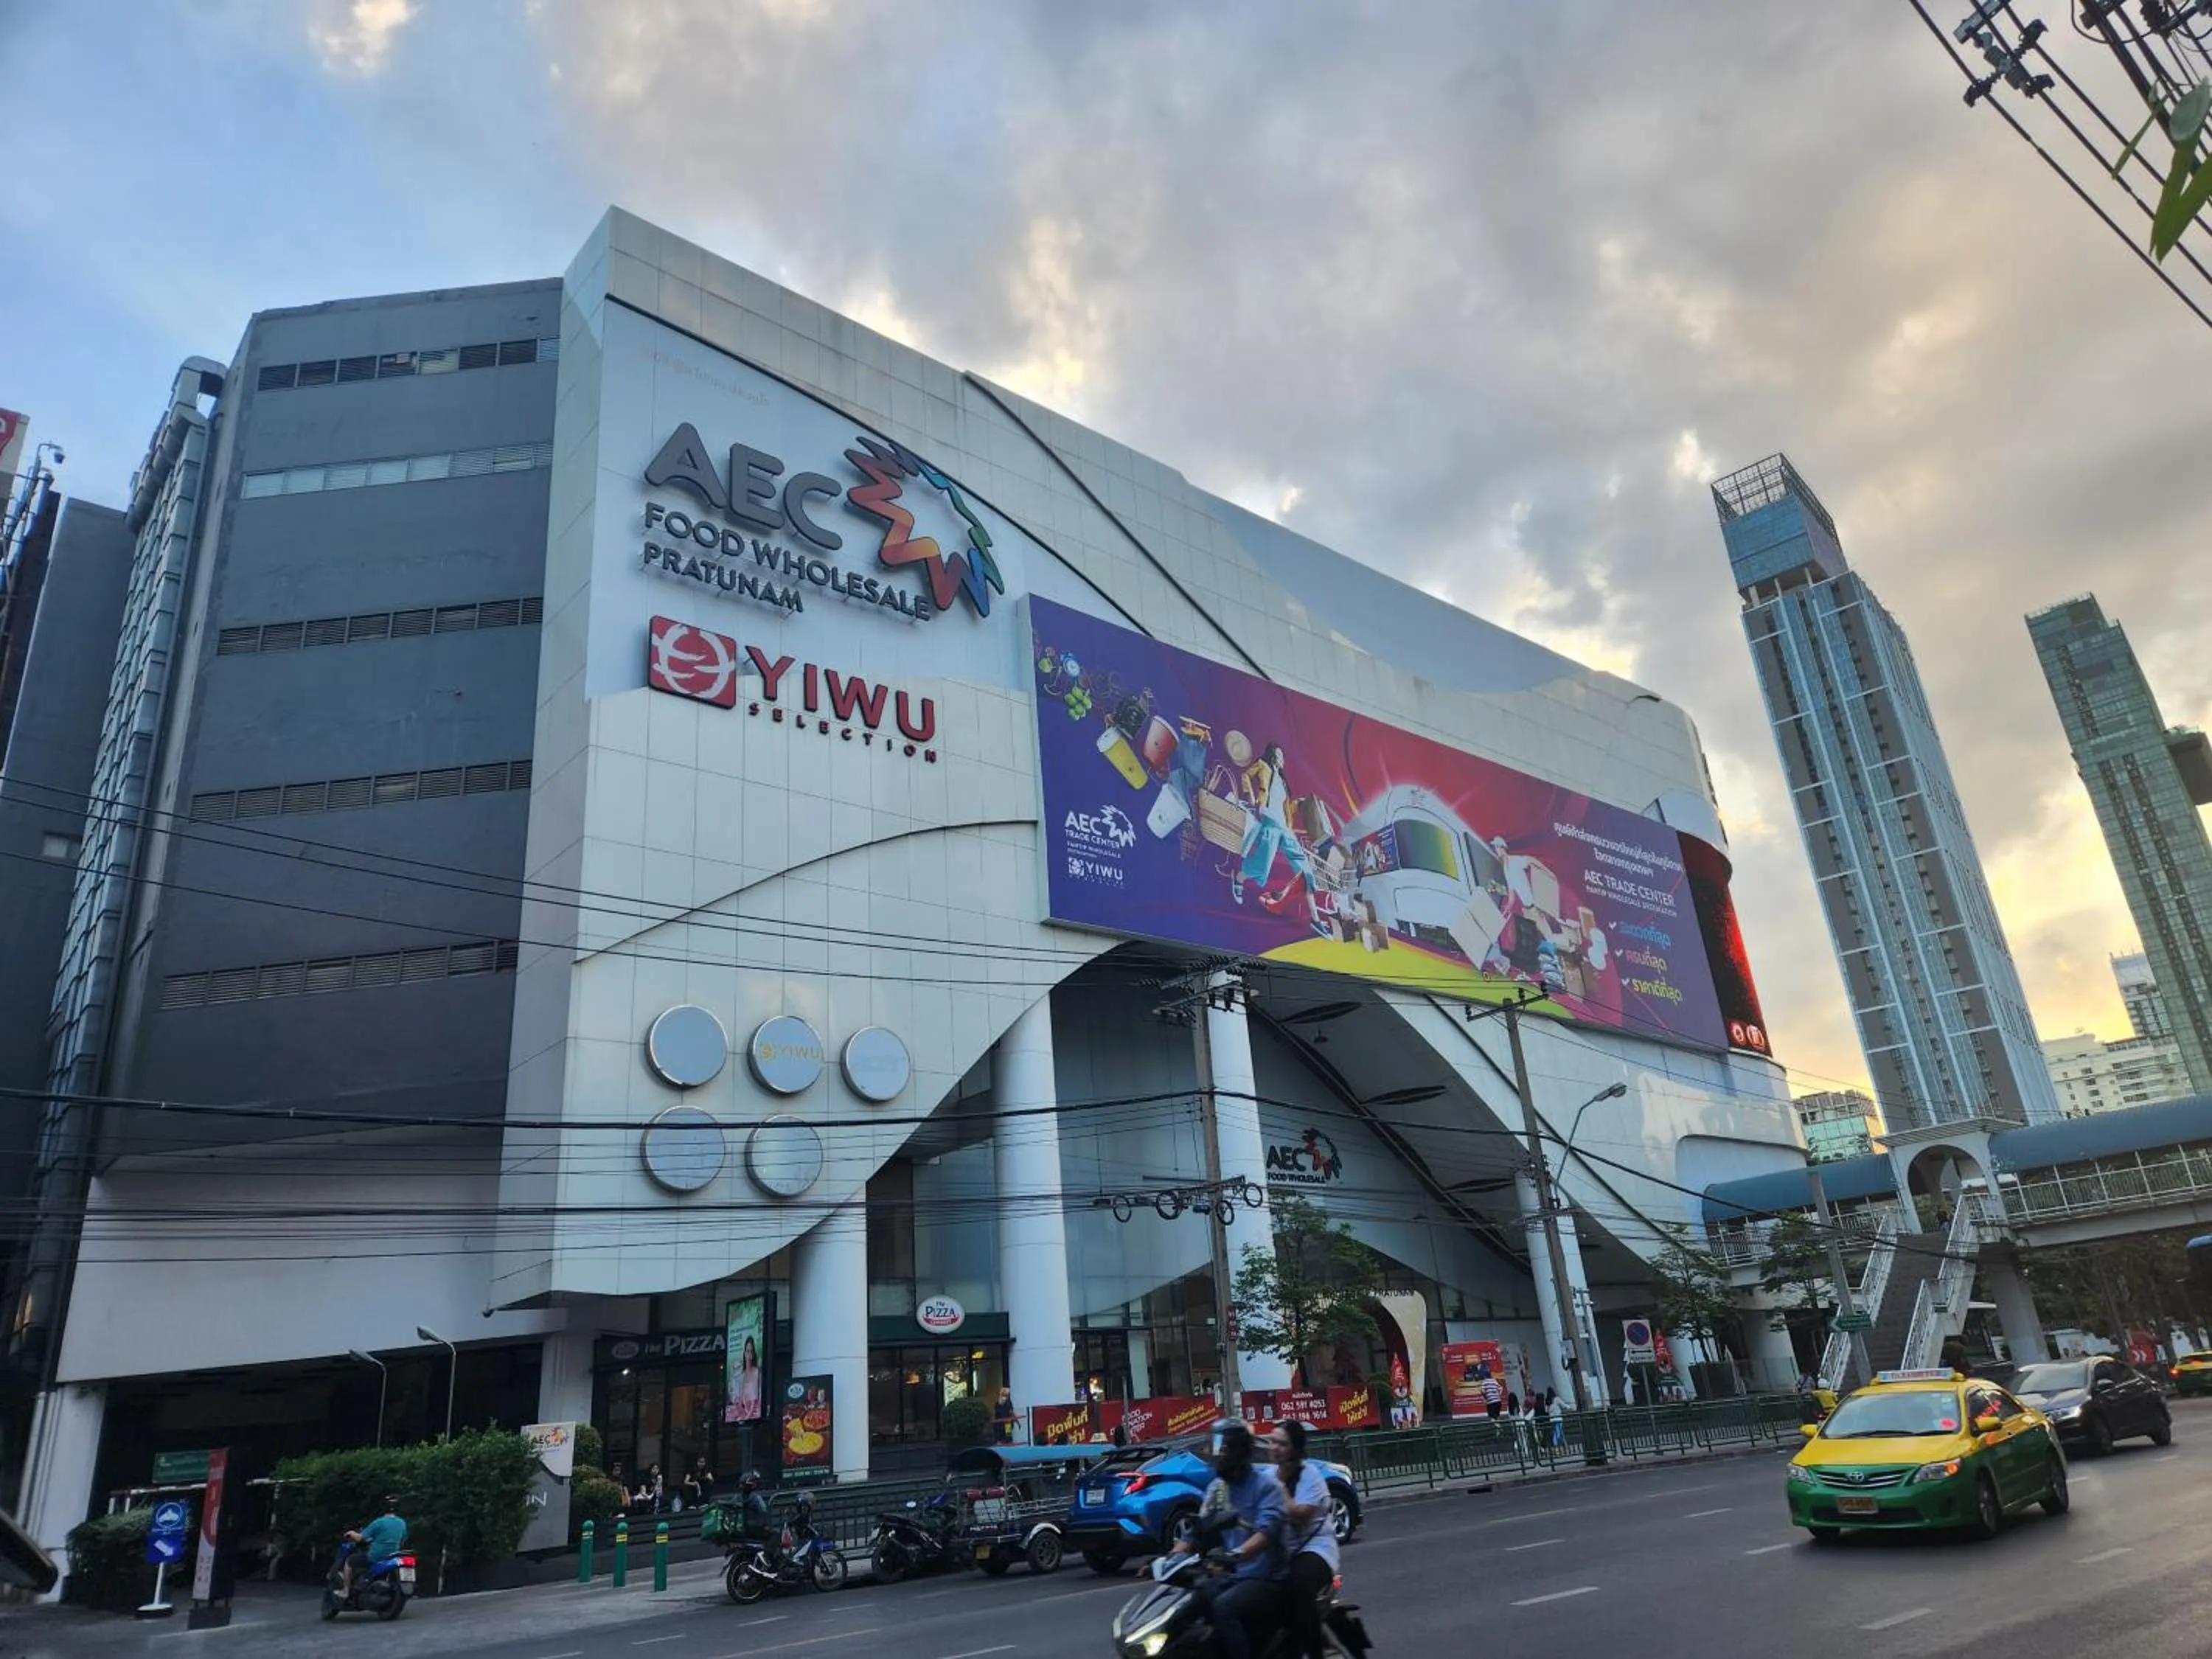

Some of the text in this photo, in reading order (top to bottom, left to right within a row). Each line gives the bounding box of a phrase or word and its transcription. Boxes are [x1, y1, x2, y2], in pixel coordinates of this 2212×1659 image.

[644, 422, 842, 550] AEC
[644, 502, 931, 621] FOOD WHOLESALE
[644, 541, 803, 613] PRATUNAM
[744, 645, 935, 742] YIWU
[748, 702, 936, 763] SELECTION
[1065, 810, 1102, 835] AEC
[1085, 860, 1123, 880] YIWU
[1585, 869, 1676, 908] AEC TRADE CENTER
[779, 1045, 820, 1060] YIWU
[1267, 1145, 1307, 1172] AEC
[925, 1306, 956, 1318] PIZZA
[664, 1334, 726, 1356] PIZZA
